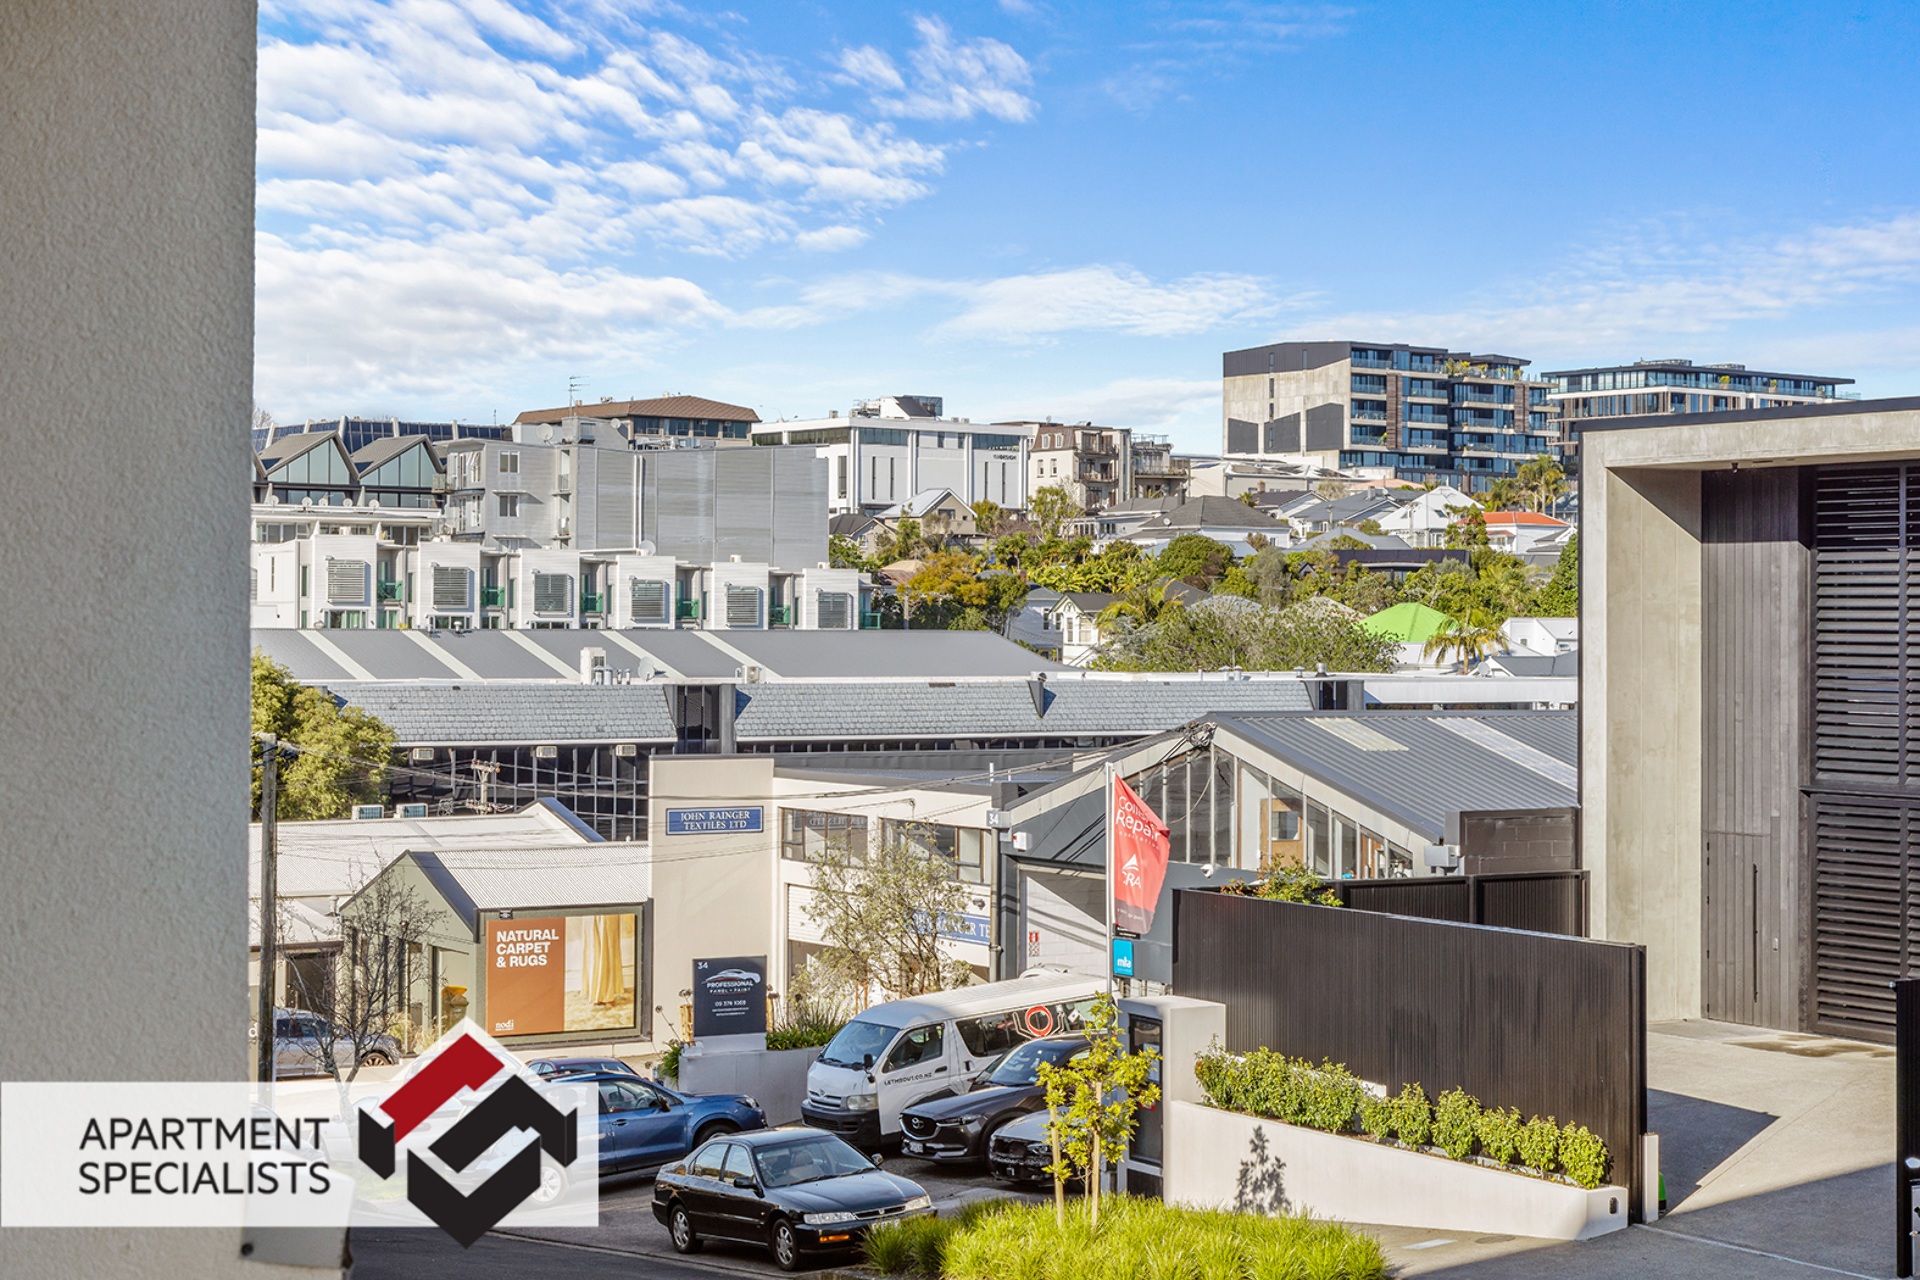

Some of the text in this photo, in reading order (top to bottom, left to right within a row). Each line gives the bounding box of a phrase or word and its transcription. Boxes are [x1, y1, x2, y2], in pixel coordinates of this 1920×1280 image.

[681, 811, 751, 821] JOHN RAINGER
[989, 813, 999, 825] 34
[684, 820, 747, 830] TEXTILES LTD
[1116, 809, 1162, 841] Repair
[497, 929, 559, 942] NATURAL
[496, 942, 551, 955] CARPET
[496, 954, 548, 968] & RUGS
